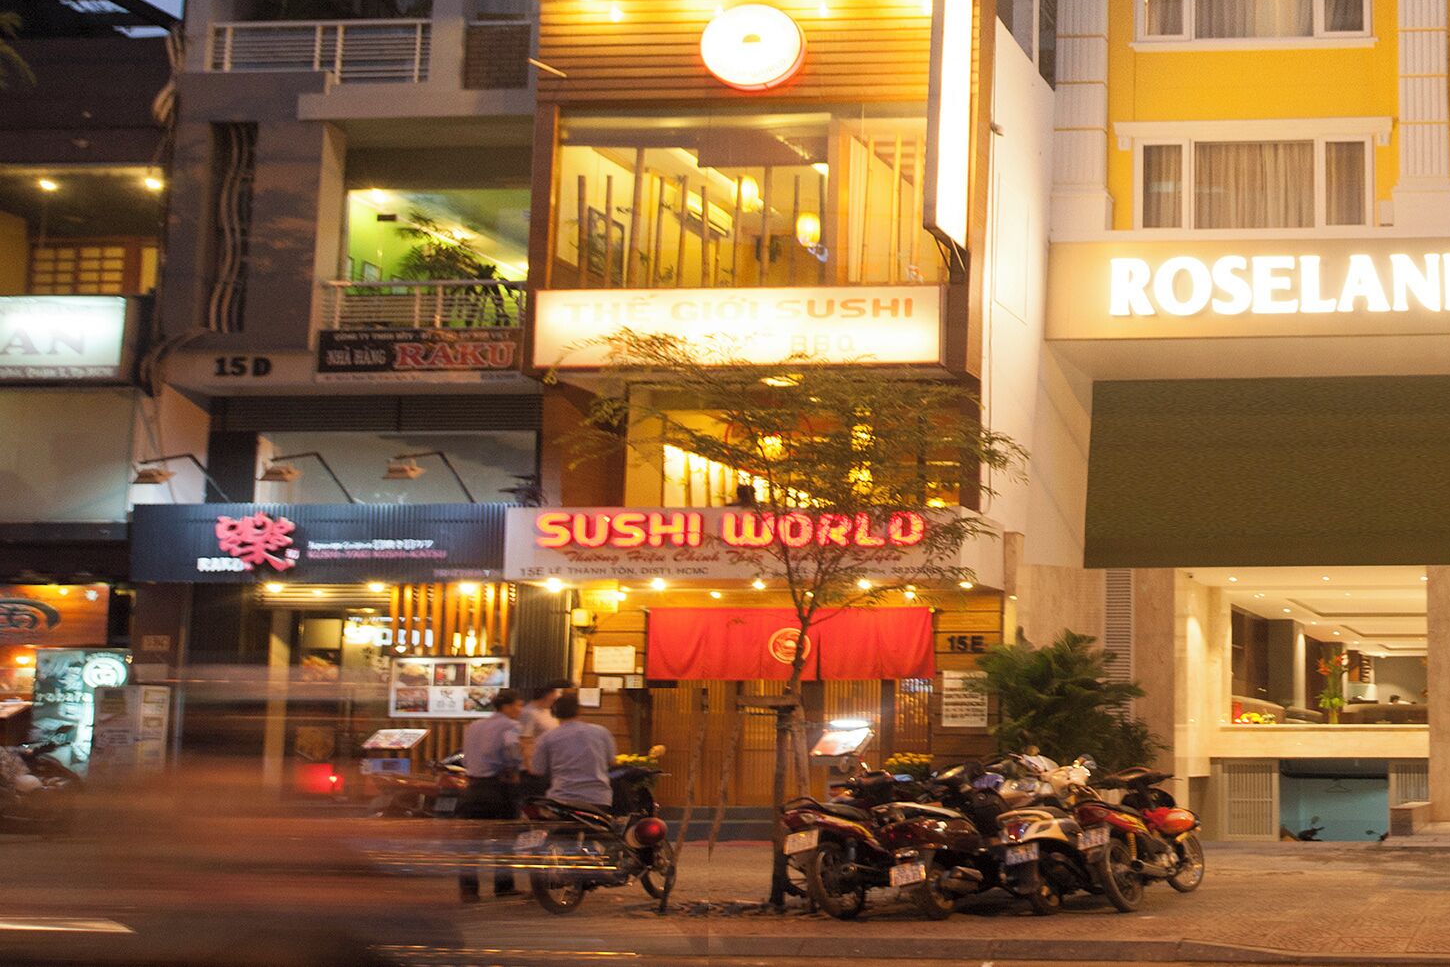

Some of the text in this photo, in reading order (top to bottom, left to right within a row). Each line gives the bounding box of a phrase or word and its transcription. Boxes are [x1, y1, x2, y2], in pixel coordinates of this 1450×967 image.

[776, 297, 914, 320] SUSHI
[392, 341, 517, 369] RAKU
[535, 510, 926, 549] SUSHI WORLD
[946, 635, 985, 653] 15E
